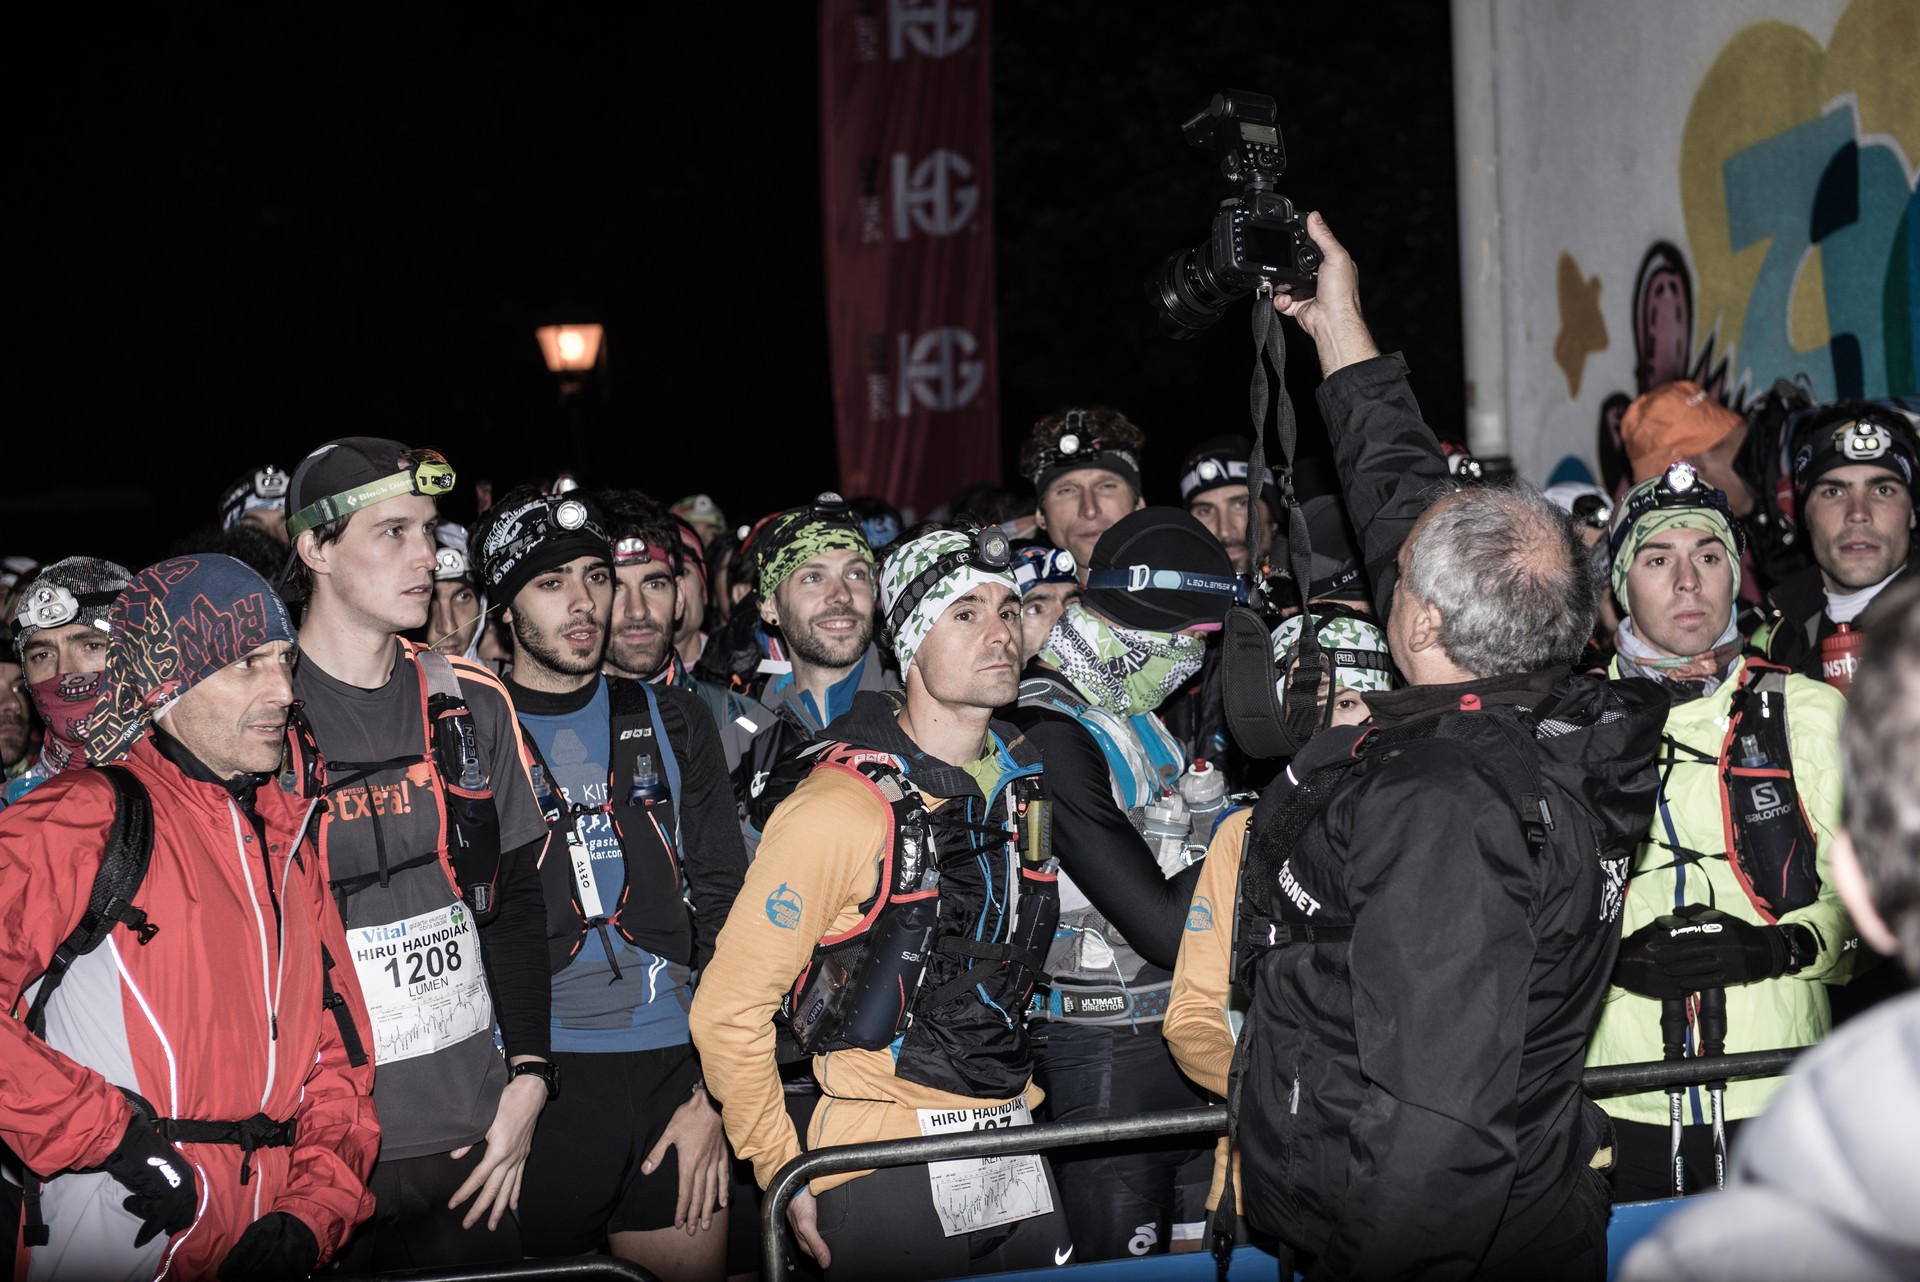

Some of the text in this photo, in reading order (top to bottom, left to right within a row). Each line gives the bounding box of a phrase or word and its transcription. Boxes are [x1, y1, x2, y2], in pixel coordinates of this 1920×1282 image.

[358, 484, 388, 502] Black
[1186, 578, 1231, 590] LED LENSER
[343, 788, 366, 796] PRESO
[408, 913, 448, 930] gizarte ekintza
[419, 919, 448, 932] obra social
[361, 922, 407, 943] Vital
[357, 921, 469, 962] HIRU HAUNDIAK
[384, 940, 462, 988] 1208
[408, 976, 449, 998] LUMEN
[1081, 996, 1124, 1007] ULTIMATE
[1082, 1002, 1125, 1012] DIRECTION
[930, 1110, 967, 1127] HIRU
[972, 1097, 1024, 1120] HAUNDIAK
